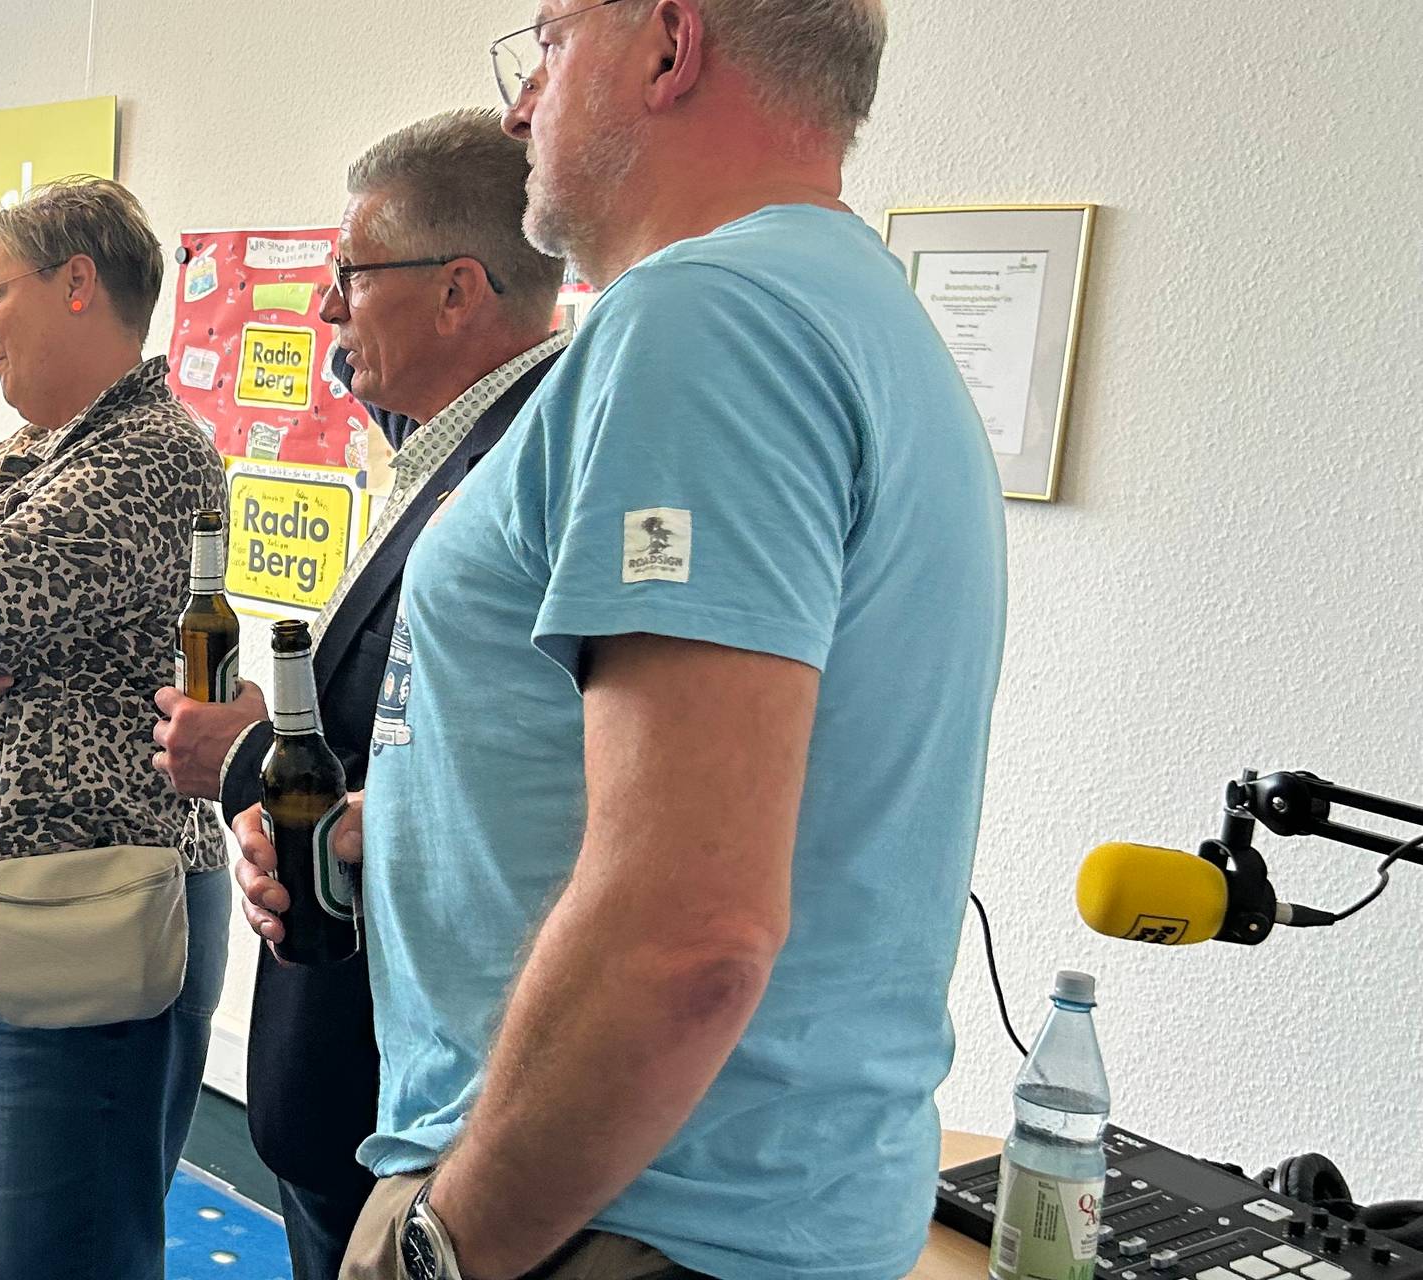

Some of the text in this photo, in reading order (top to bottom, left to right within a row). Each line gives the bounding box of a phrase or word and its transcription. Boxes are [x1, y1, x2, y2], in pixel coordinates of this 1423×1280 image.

[253, 341, 302, 367] Radio
[254, 366, 295, 398] Berg
[243, 498, 330, 543] Radio
[248, 538, 318, 593] Berg
[628, 554, 683, 569] ROADSIGN
